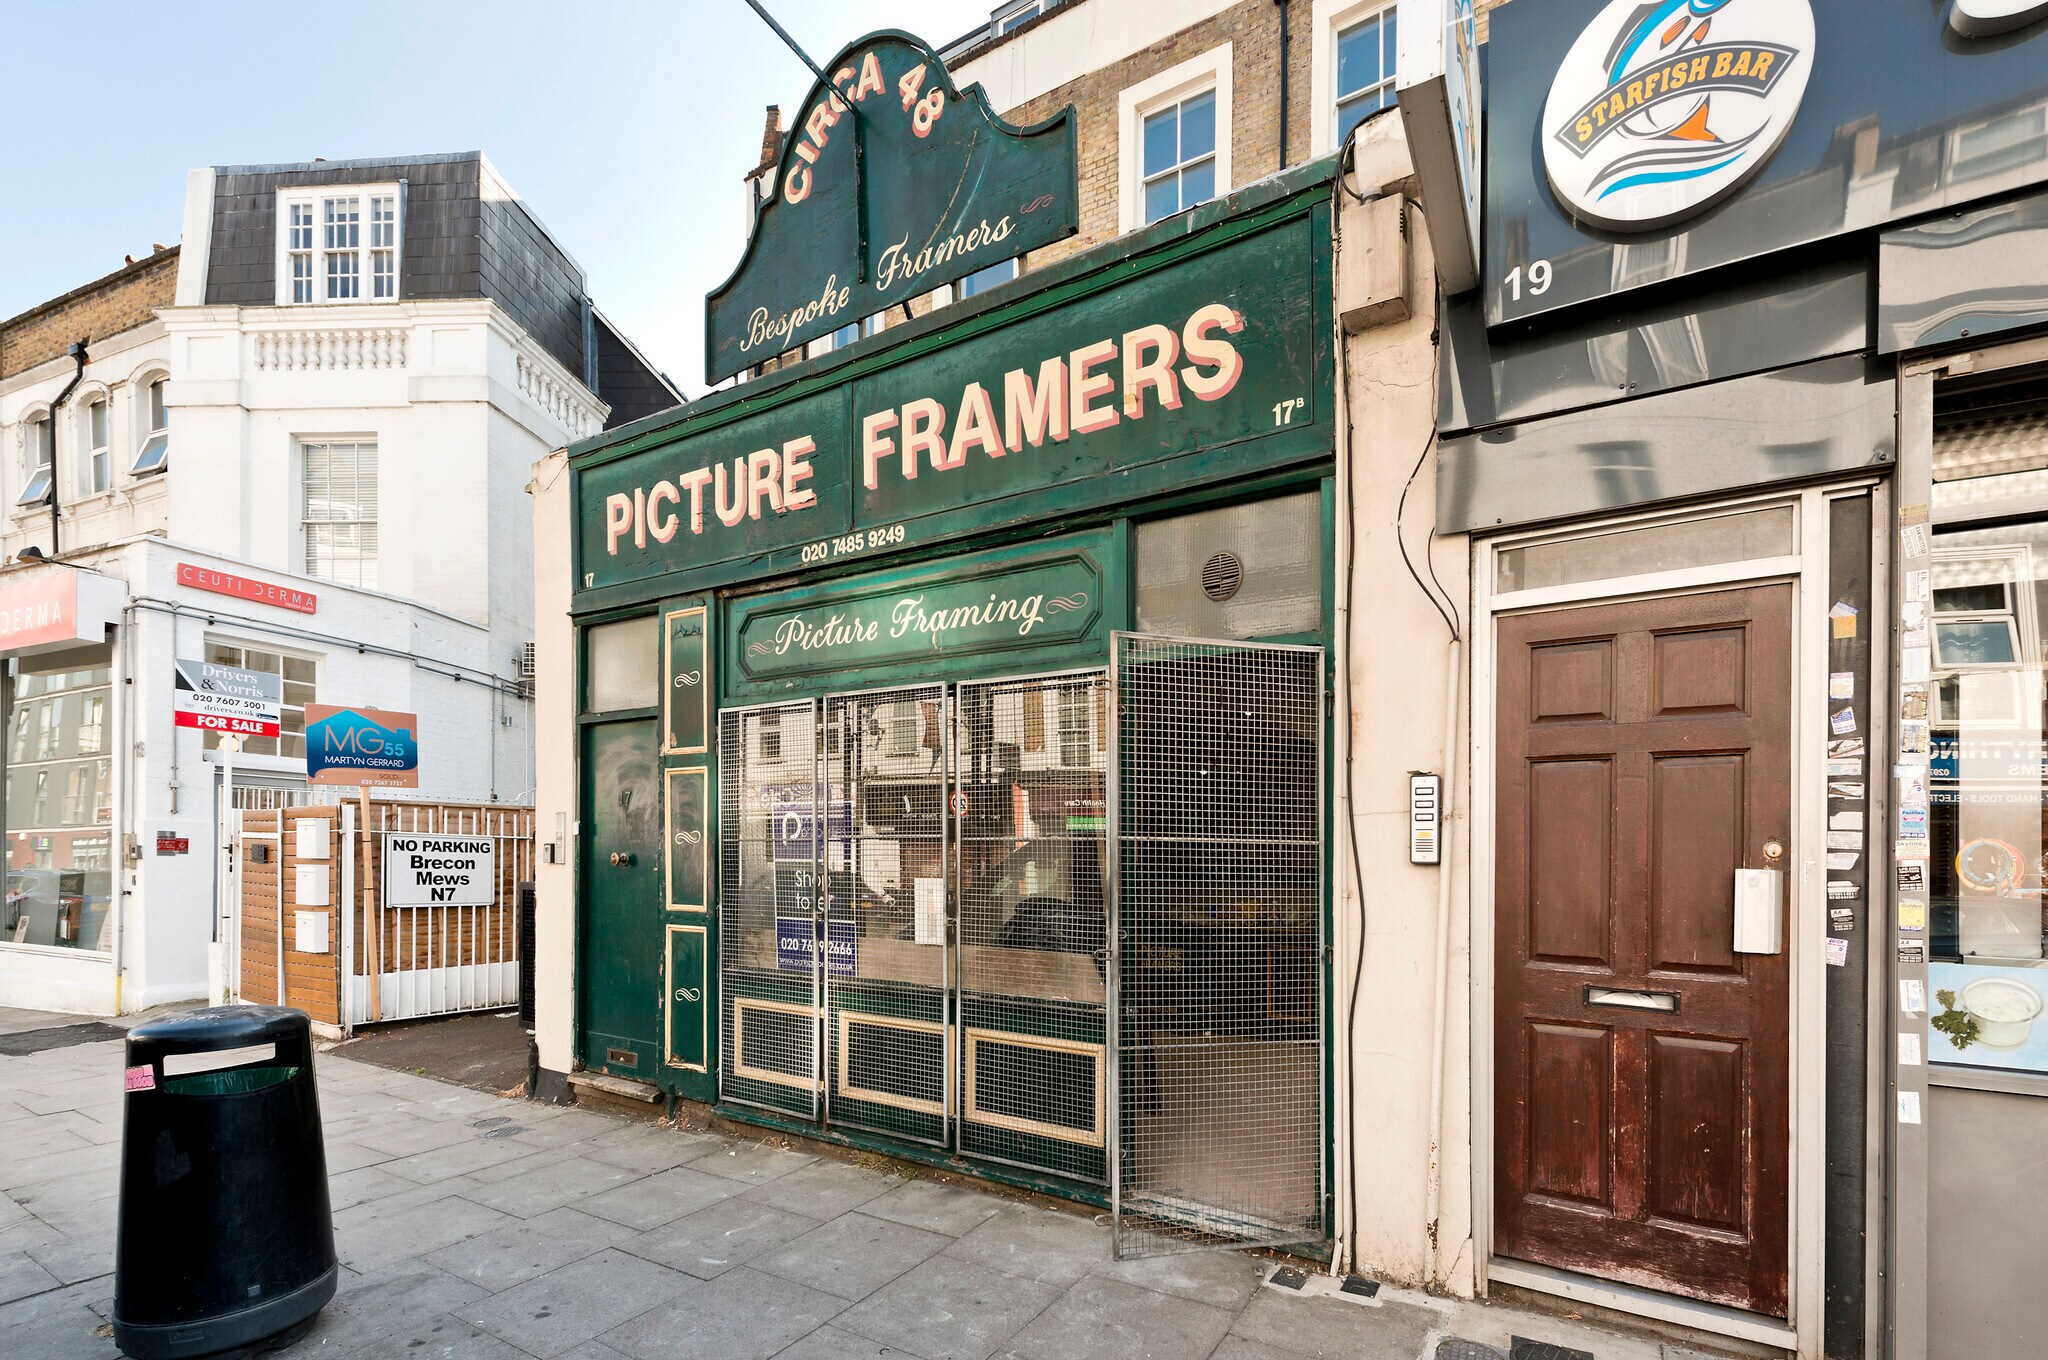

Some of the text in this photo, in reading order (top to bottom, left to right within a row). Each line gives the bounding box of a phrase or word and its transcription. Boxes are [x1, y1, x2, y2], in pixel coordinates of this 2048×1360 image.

[1575, 49, 1776, 143] STARFISH BAR
[784, 51, 945, 206] CIRCA 48
[739, 214, 1017, 353] Bespoke Framers
[1504, 258, 1553, 301] 19
[606, 302, 1245, 556] PICTURE FRAMERS
[801, 524, 906, 563] 020 7485 9249
[182, 567, 242, 591] CEUTI
[584, 572, 595, 588] 17
[774, 593, 1044, 656] Picture Framing
[201, 664, 258, 684] Drivers
[192, 693, 266, 711] 020 7607 5001
[204, 704, 255, 718] drivers.co.uk
[197, 715, 264, 734] FOR SALE
[324, 755, 405, 768] MARTYN GERRARD
[393, 839, 491, 854] NO PARKING
[410, 855, 476, 870] Brecon
[416, 871, 470, 886] Mews
[431, 887, 456, 902] N7
[781, 937, 799, 951] 020
[802, 939, 825, 953] 769
